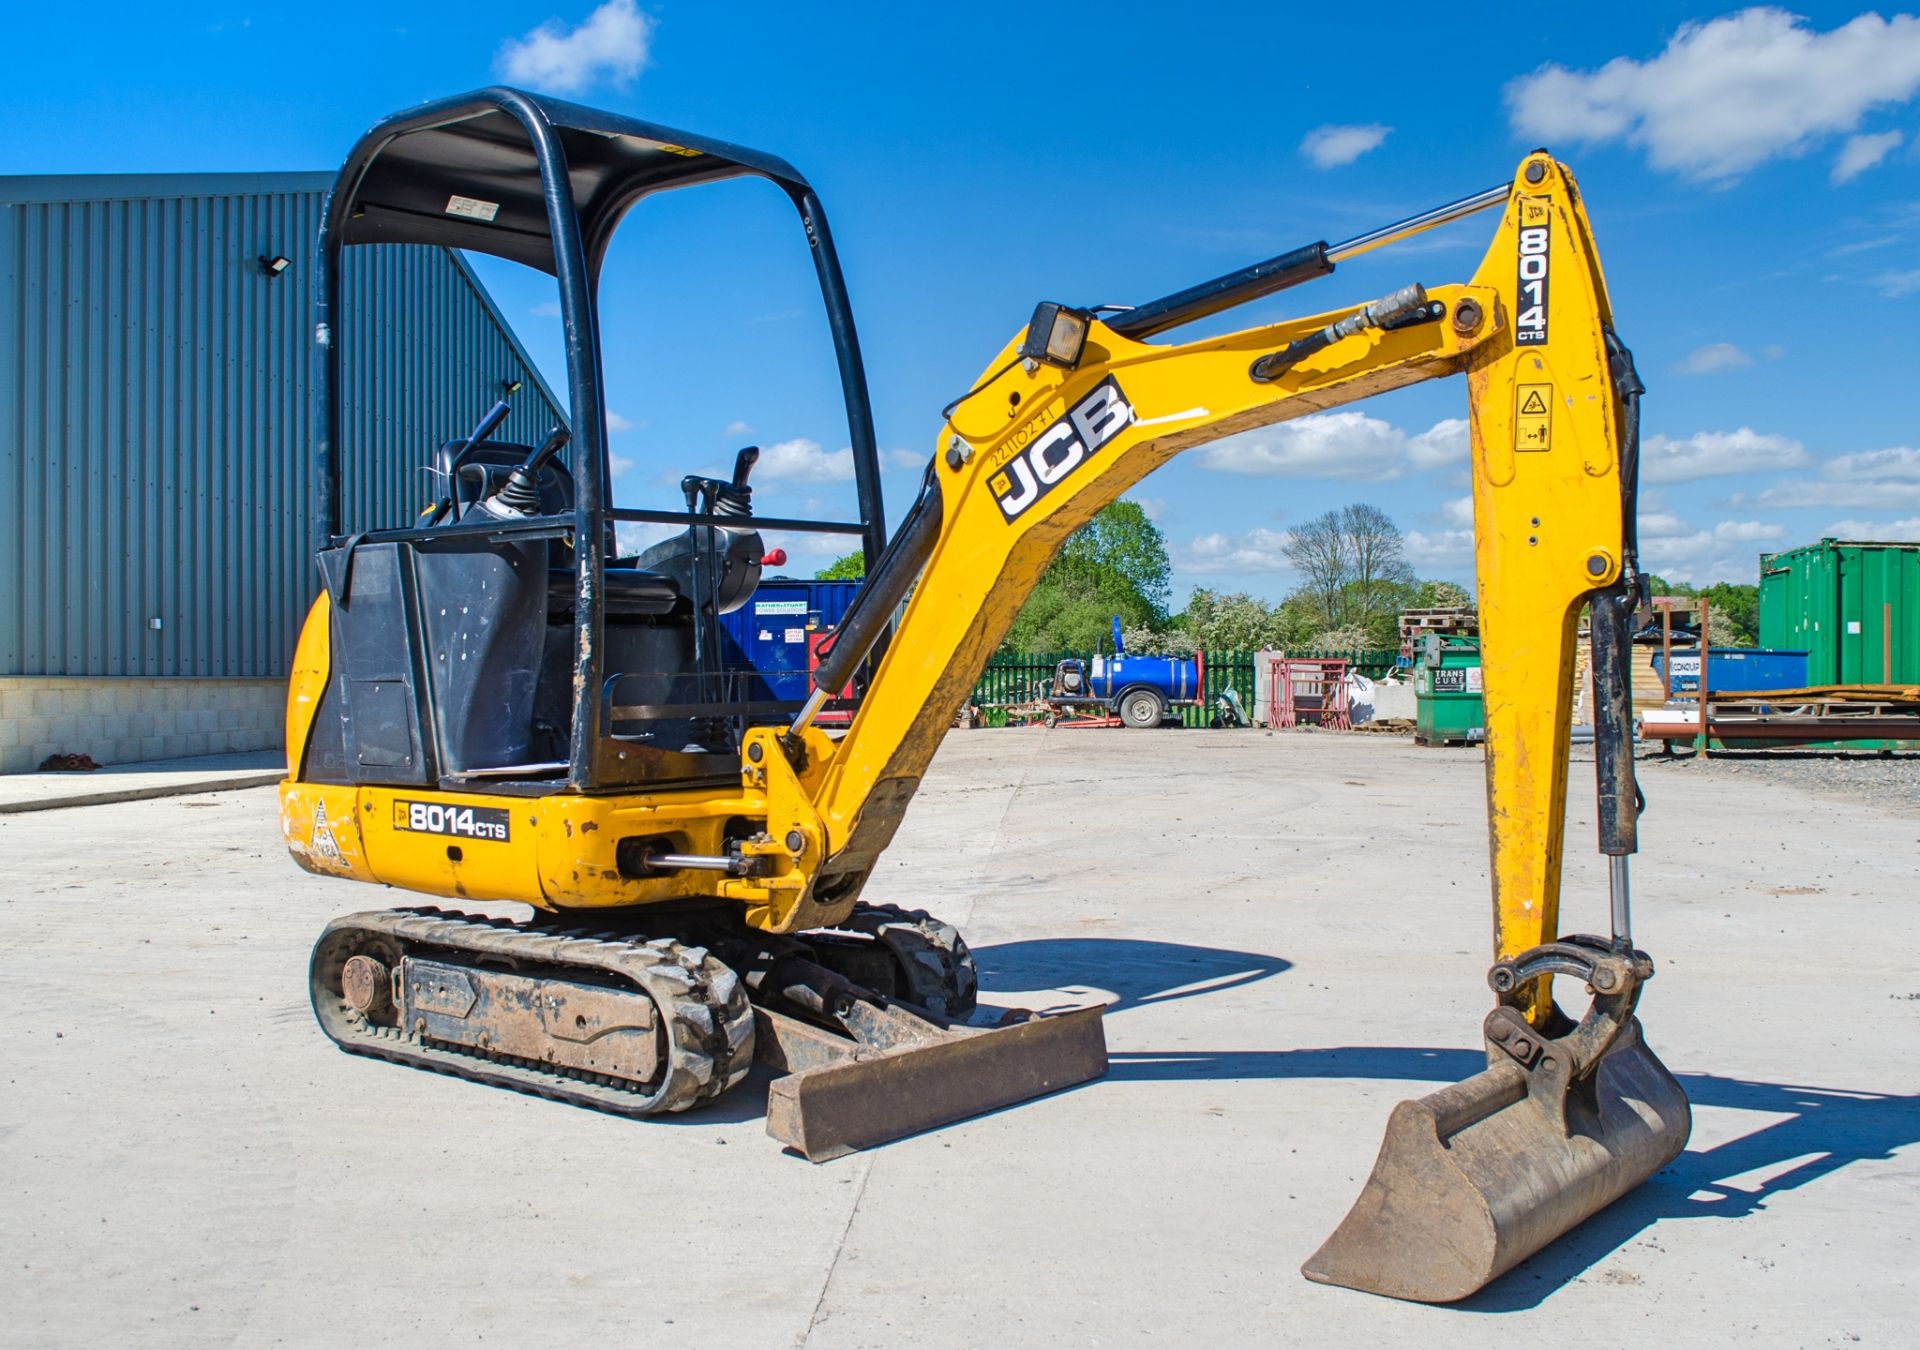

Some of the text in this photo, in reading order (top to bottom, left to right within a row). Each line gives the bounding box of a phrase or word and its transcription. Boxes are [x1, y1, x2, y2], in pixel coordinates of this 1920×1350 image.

[1528, 205, 1544, 219] JCB
[1517, 228, 1548, 331] 8014
[1518, 331, 1545, 341] CTS
[990, 406, 1056, 468] 22110271
[1000, 384, 1129, 516] JCB
